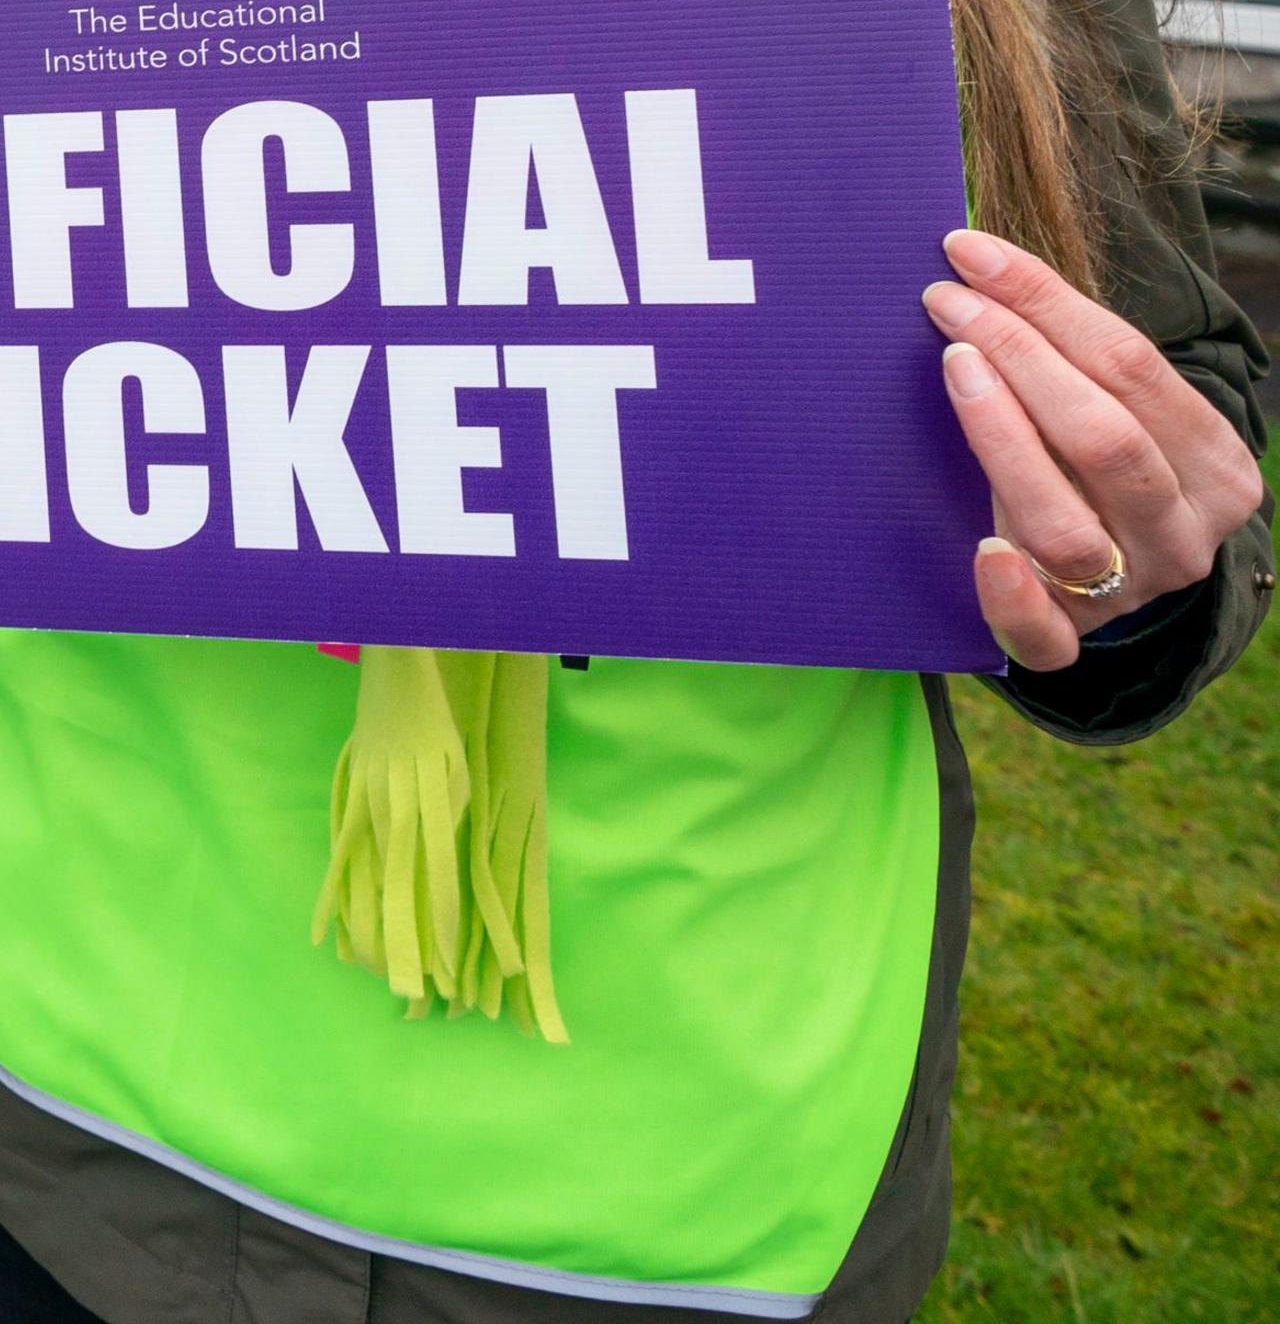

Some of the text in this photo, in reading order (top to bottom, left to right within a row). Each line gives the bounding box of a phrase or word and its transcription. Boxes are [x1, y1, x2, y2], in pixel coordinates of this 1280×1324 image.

[68, 7, 128, 35] The
[44, 30, 362, 74] Institute of Scotland
